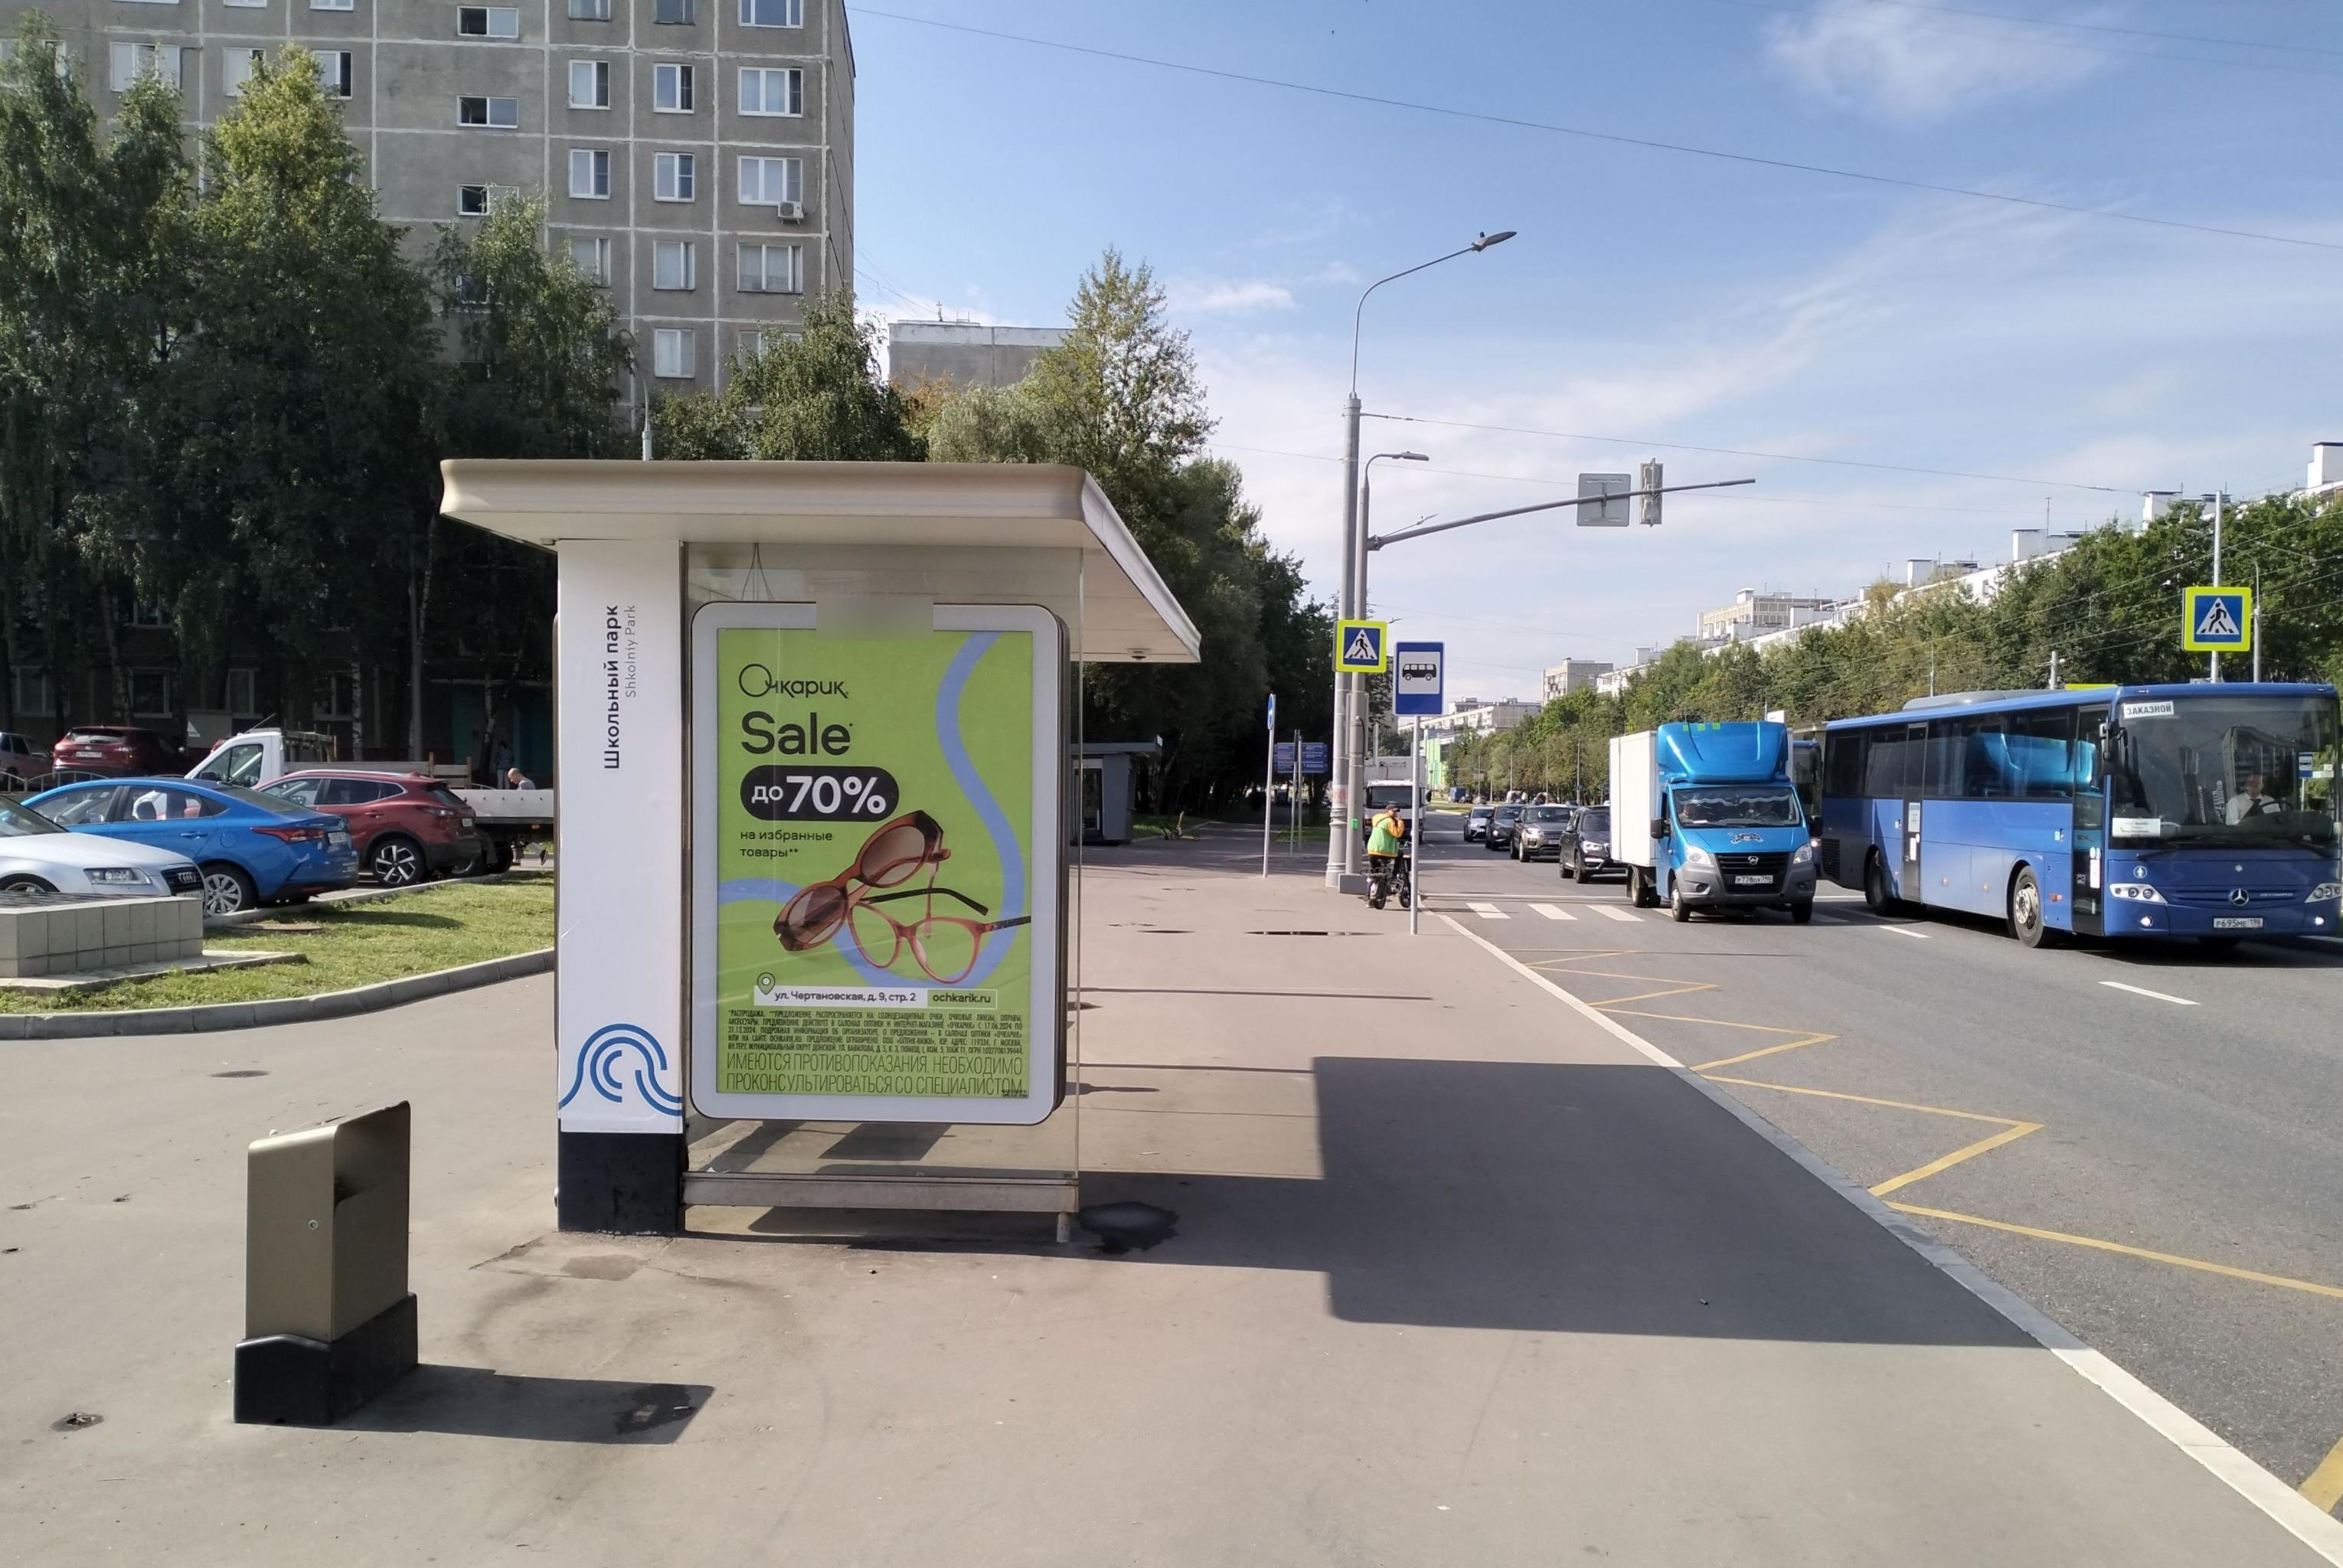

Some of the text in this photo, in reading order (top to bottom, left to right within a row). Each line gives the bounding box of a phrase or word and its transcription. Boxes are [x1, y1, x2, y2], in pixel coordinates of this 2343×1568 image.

[624, 604, 639, 698] Shkolniy Park
[603, 606, 622, 769] Школьный парк
[739, 664, 848, 698] Очкарик
[2126, 704, 2171, 715] ЗАКАЗНОЙ
[752, 776, 886, 814] до 70%
[740, 829, 833, 843] на избранные
[775, 991, 916, 1003] ул. Чертановская, д. 9, стр. 2
[933, 993, 991, 1003] ochkarik.ru
[727, 1053, 1022, 1076] ИМЕЮТСЯ ПРОТИВОПОКАЗАНИЯ. НЕОБХОДИМО
[727, 1073, 893, 1093] ПРОКОНСУЛЬТИРОВАТЬСЯ
[895, 1076, 913, 1093] СО
[917, 1077, 1022, 1097] СПЕЦИАЛИСТОМ
